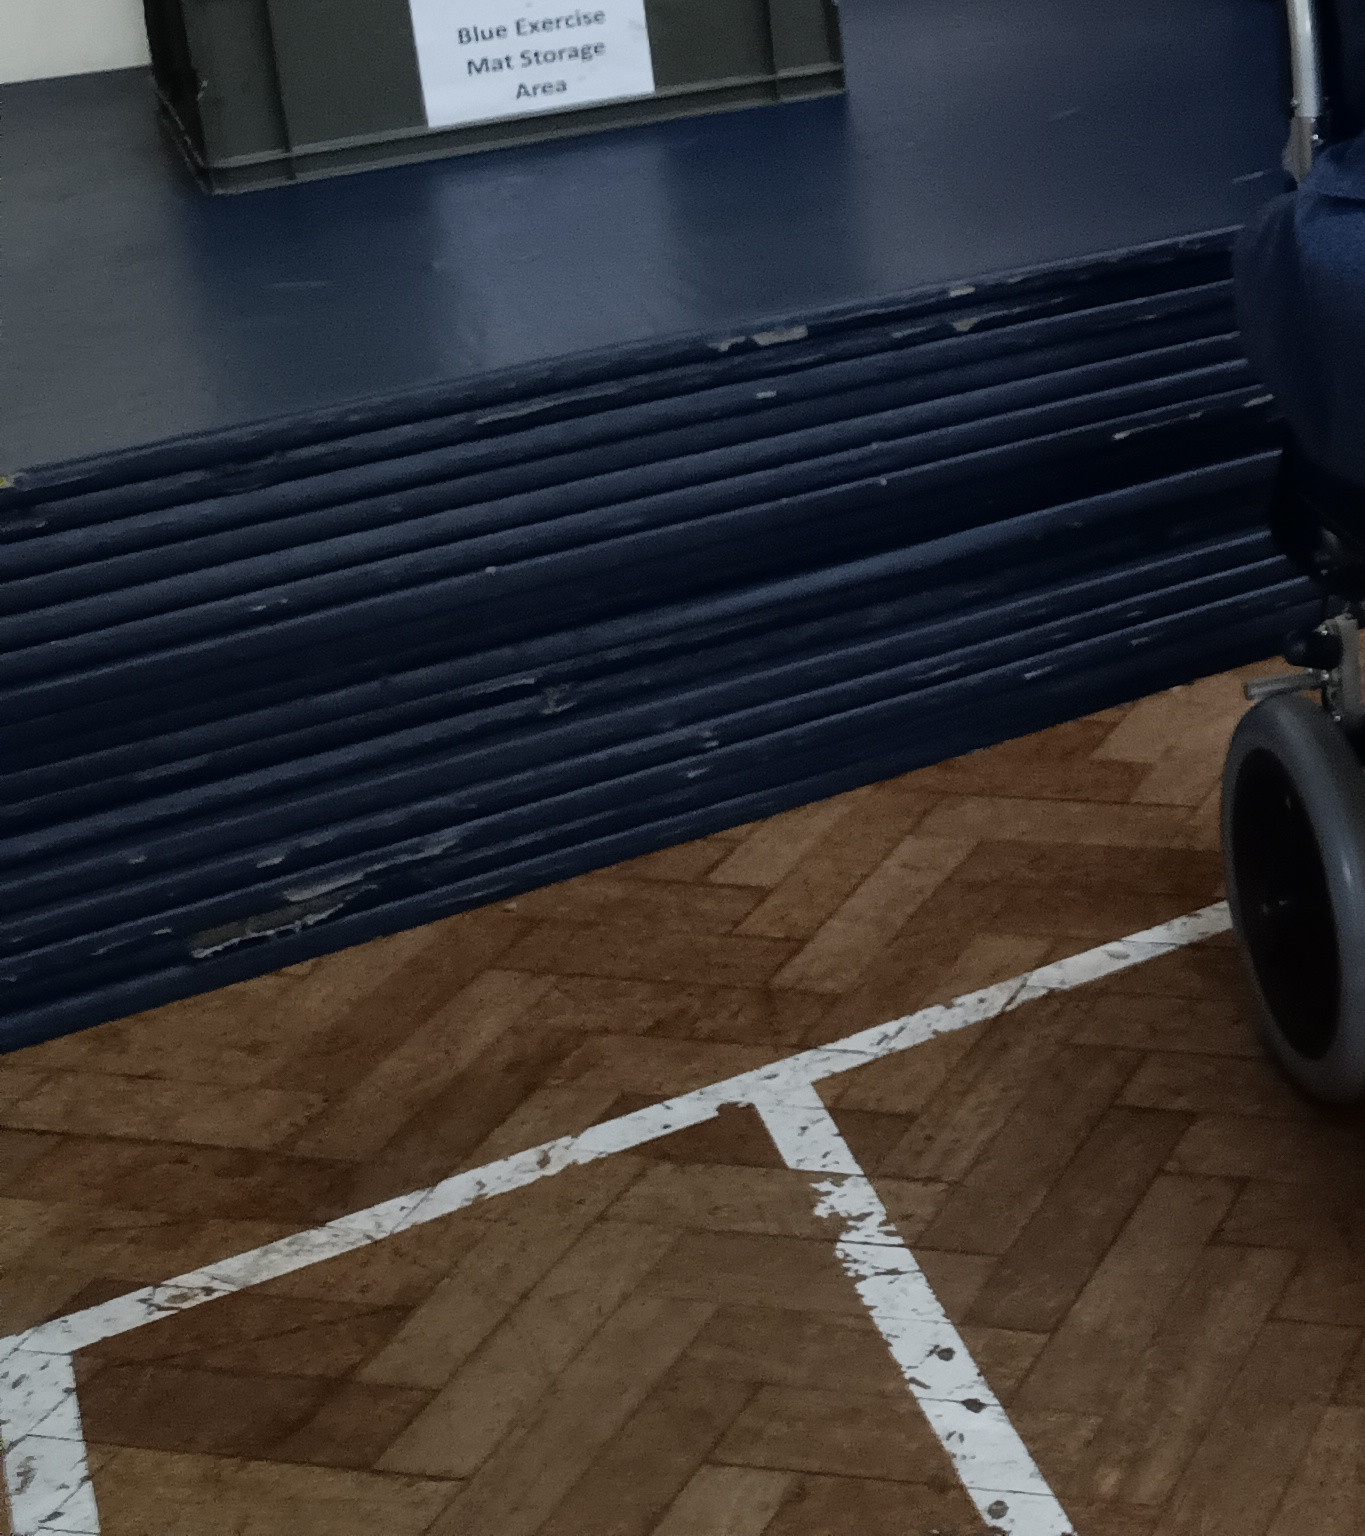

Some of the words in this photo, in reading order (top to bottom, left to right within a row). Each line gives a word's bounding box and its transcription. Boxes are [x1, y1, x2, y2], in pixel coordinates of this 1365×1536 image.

[458, 22, 507, 46] Blue
[516, 7, 606, 36] Exercise
[467, 53, 514, 77] Mat
[520, 40, 607, 69] Storage
[516, 77, 567, 99] Area
